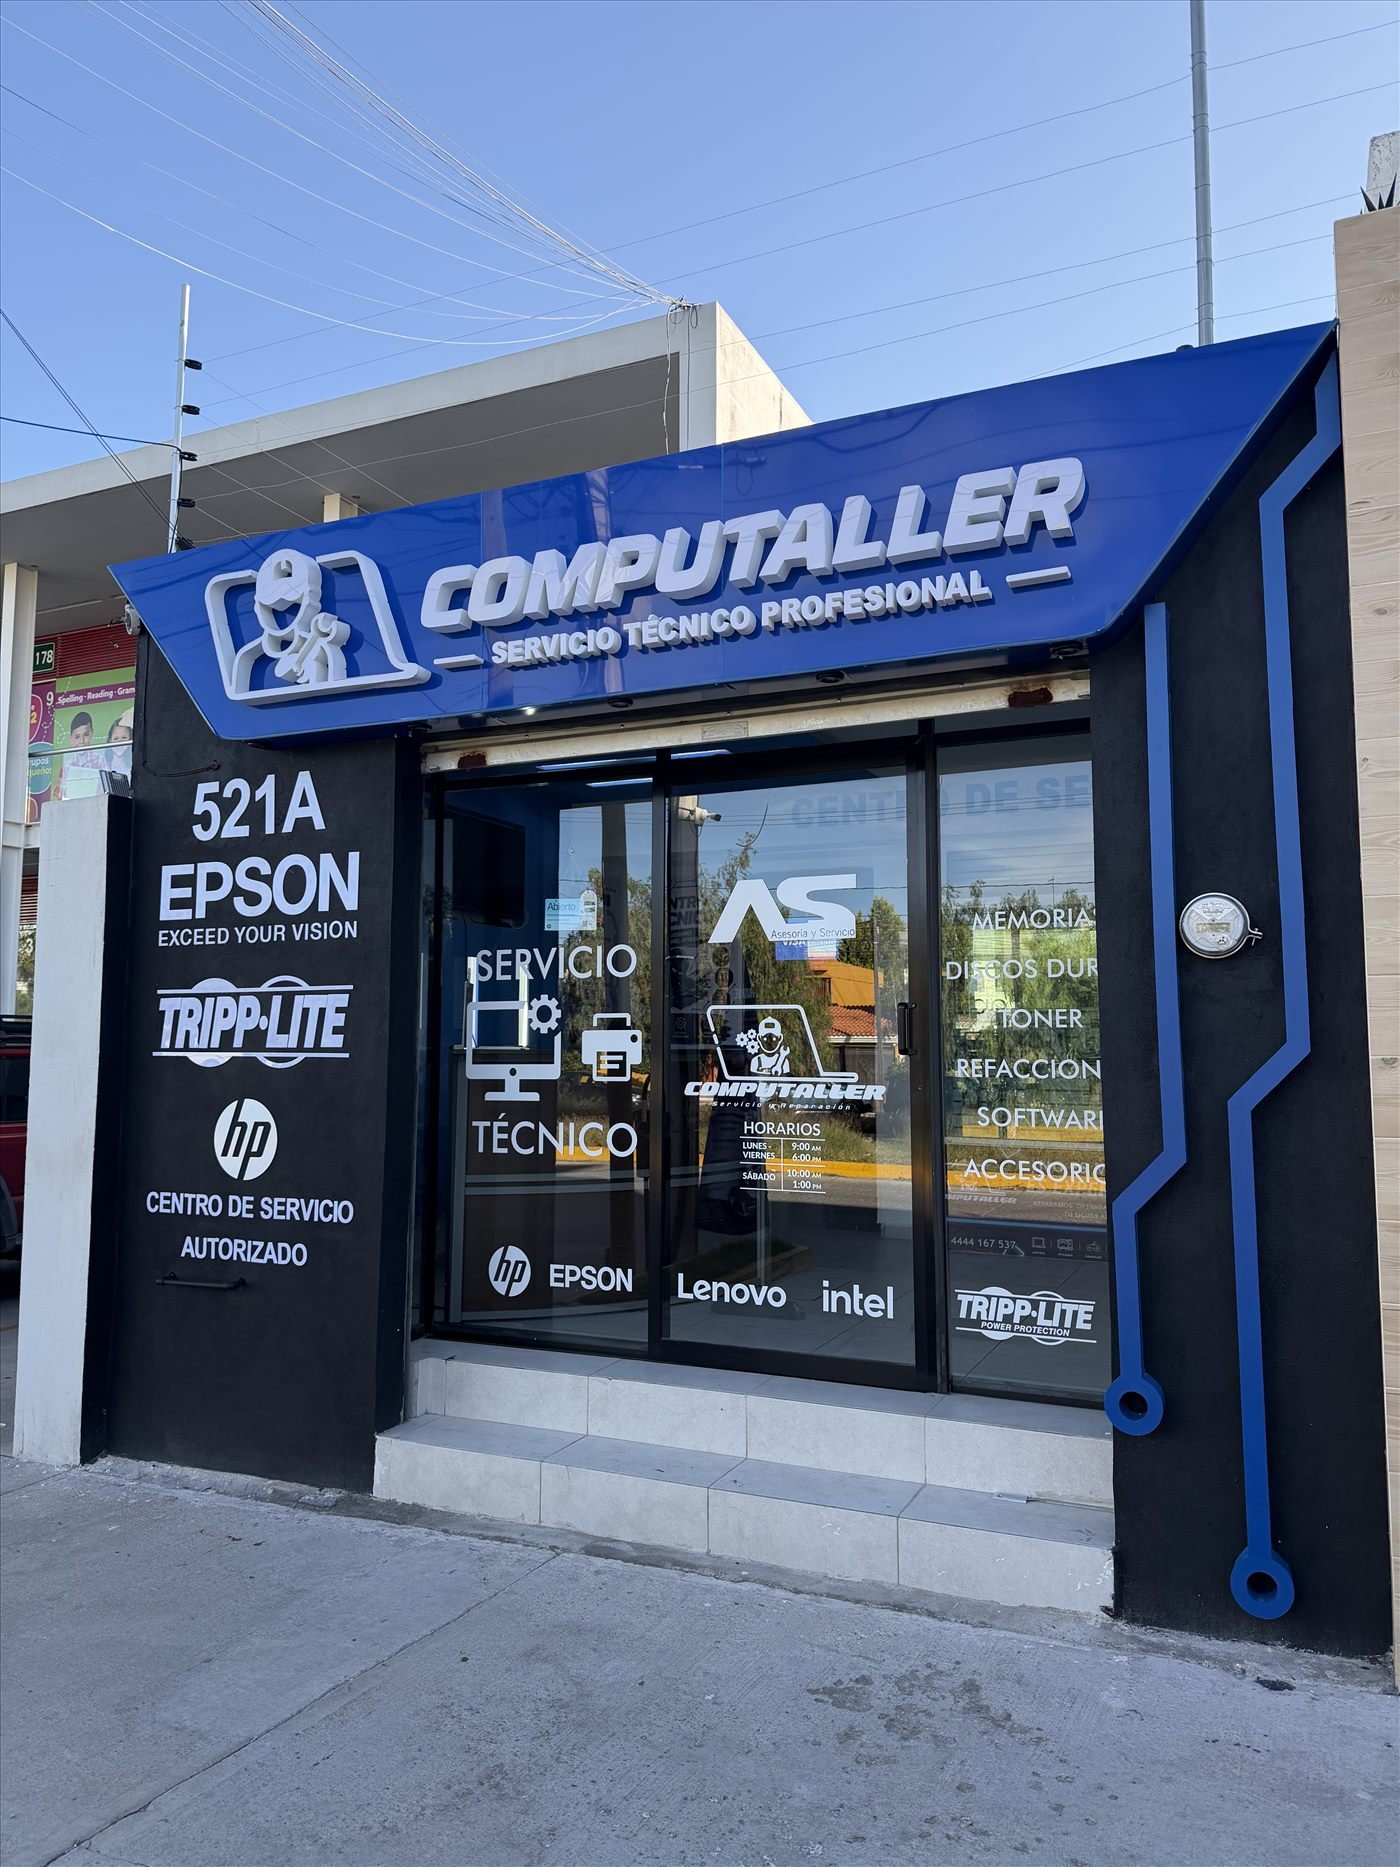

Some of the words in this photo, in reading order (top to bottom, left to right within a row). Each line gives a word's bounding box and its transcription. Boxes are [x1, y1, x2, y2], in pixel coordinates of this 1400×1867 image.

[420, 457, 1085, 633] COMPUTALLER
[491, 625, 621, 669] SERVICIO
[624, 600, 757, 651] TÉCNICO
[761, 569, 992, 631] PROFESIONAL
[35, 650, 53, 666] 178
[57, 694, 83, 706] Spelling
[87, 688, 114, 701] Reading
[192, 770, 326, 842] 521A
[159, 851, 360, 921] EPSON
[547, 901, 576, 911] Abierto
[708, 874, 856, 943] AS
[973, 908, 1096, 930] MEMORIA
[158, 927, 229, 947] EXCEED
[234, 924, 286, 944] YOUR
[292, 920, 358, 942] VISION
[771, 927, 808, 939] Asesoría
[811, 930, 818, 938] y
[819, 926, 856, 938] Servicio
[476, 944, 637, 982] SERVICIO
[945, 959, 1037, 980] DISCOS
[996, 1008, 1084, 1029] TONER
[957, 1058, 1102, 1080] REFACCION
[684, 1081, 887, 1101] COMPUTALLER
[780, 1102, 851, 1110] Reparación
[472, 1113, 638, 1158] TÉCNICO
[744, 1121, 821, 1136] HORARIOS
[217, 1099, 275, 1180] hp
[742, 1142, 767, 1150] LUNES
[791, 1142, 810, 1151] 9:00
[742, 1151, 775, 1160] VIERNES
[792, 1153, 811, 1162] 6:00
[742, 1171, 776, 1181] SÁBADO
[787, 1168, 811, 1178] 10:00
[793, 1180, 811, 1189] 1:00
[146, 1191, 223, 1217] CENTRO
[228, 1195, 254, 1219] DE
[260, 1197, 354, 1224] SERVICIO
[181, 1235, 308, 1266] AUTORIZADO
[951, 1237, 974, 1246] 4444
[977, 1239, 995, 1247] 167
[998, 1240, 1016, 1249] 537
[491, 1245, 530, 1297] hp
[549, 1263, 633, 1292] EPSON
[677, 1273, 787, 1308] Lenovo
[822, 1280, 894, 1319] intel
[981, 1321, 1012, 1332] POWER
[1014, 1324, 1070, 1337] PROTECTION
